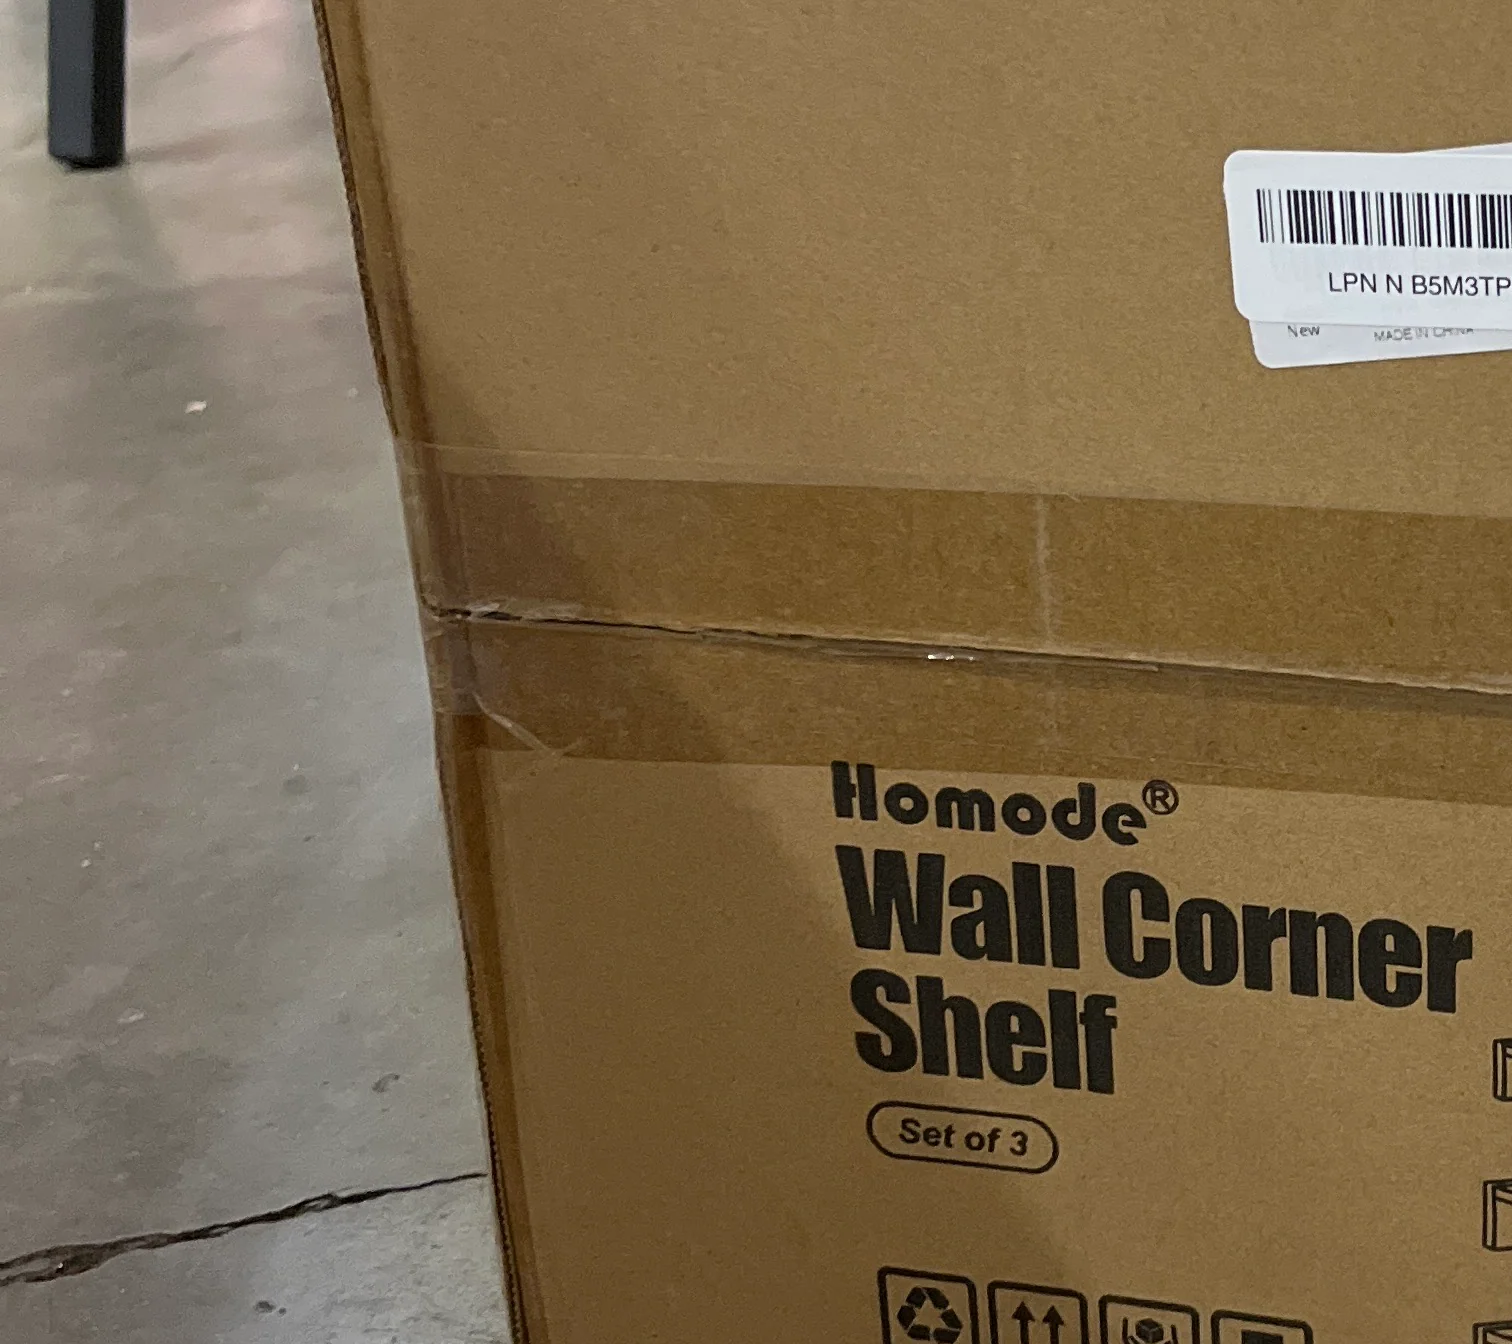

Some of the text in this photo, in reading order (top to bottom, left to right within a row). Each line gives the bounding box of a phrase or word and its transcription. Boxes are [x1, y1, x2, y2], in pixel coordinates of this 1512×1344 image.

[1328, 270, 1378, 295] LPN
[1385, 273, 1404, 295] N
[1287, 324, 1320, 338] New
[1374, 328, 1413, 342] MADE
[835, 845, 1474, 1014] Wall Corner
[849, 968, 1118, 1095] Shelf
[899, 1118, 1028, 1156] Set of 3
